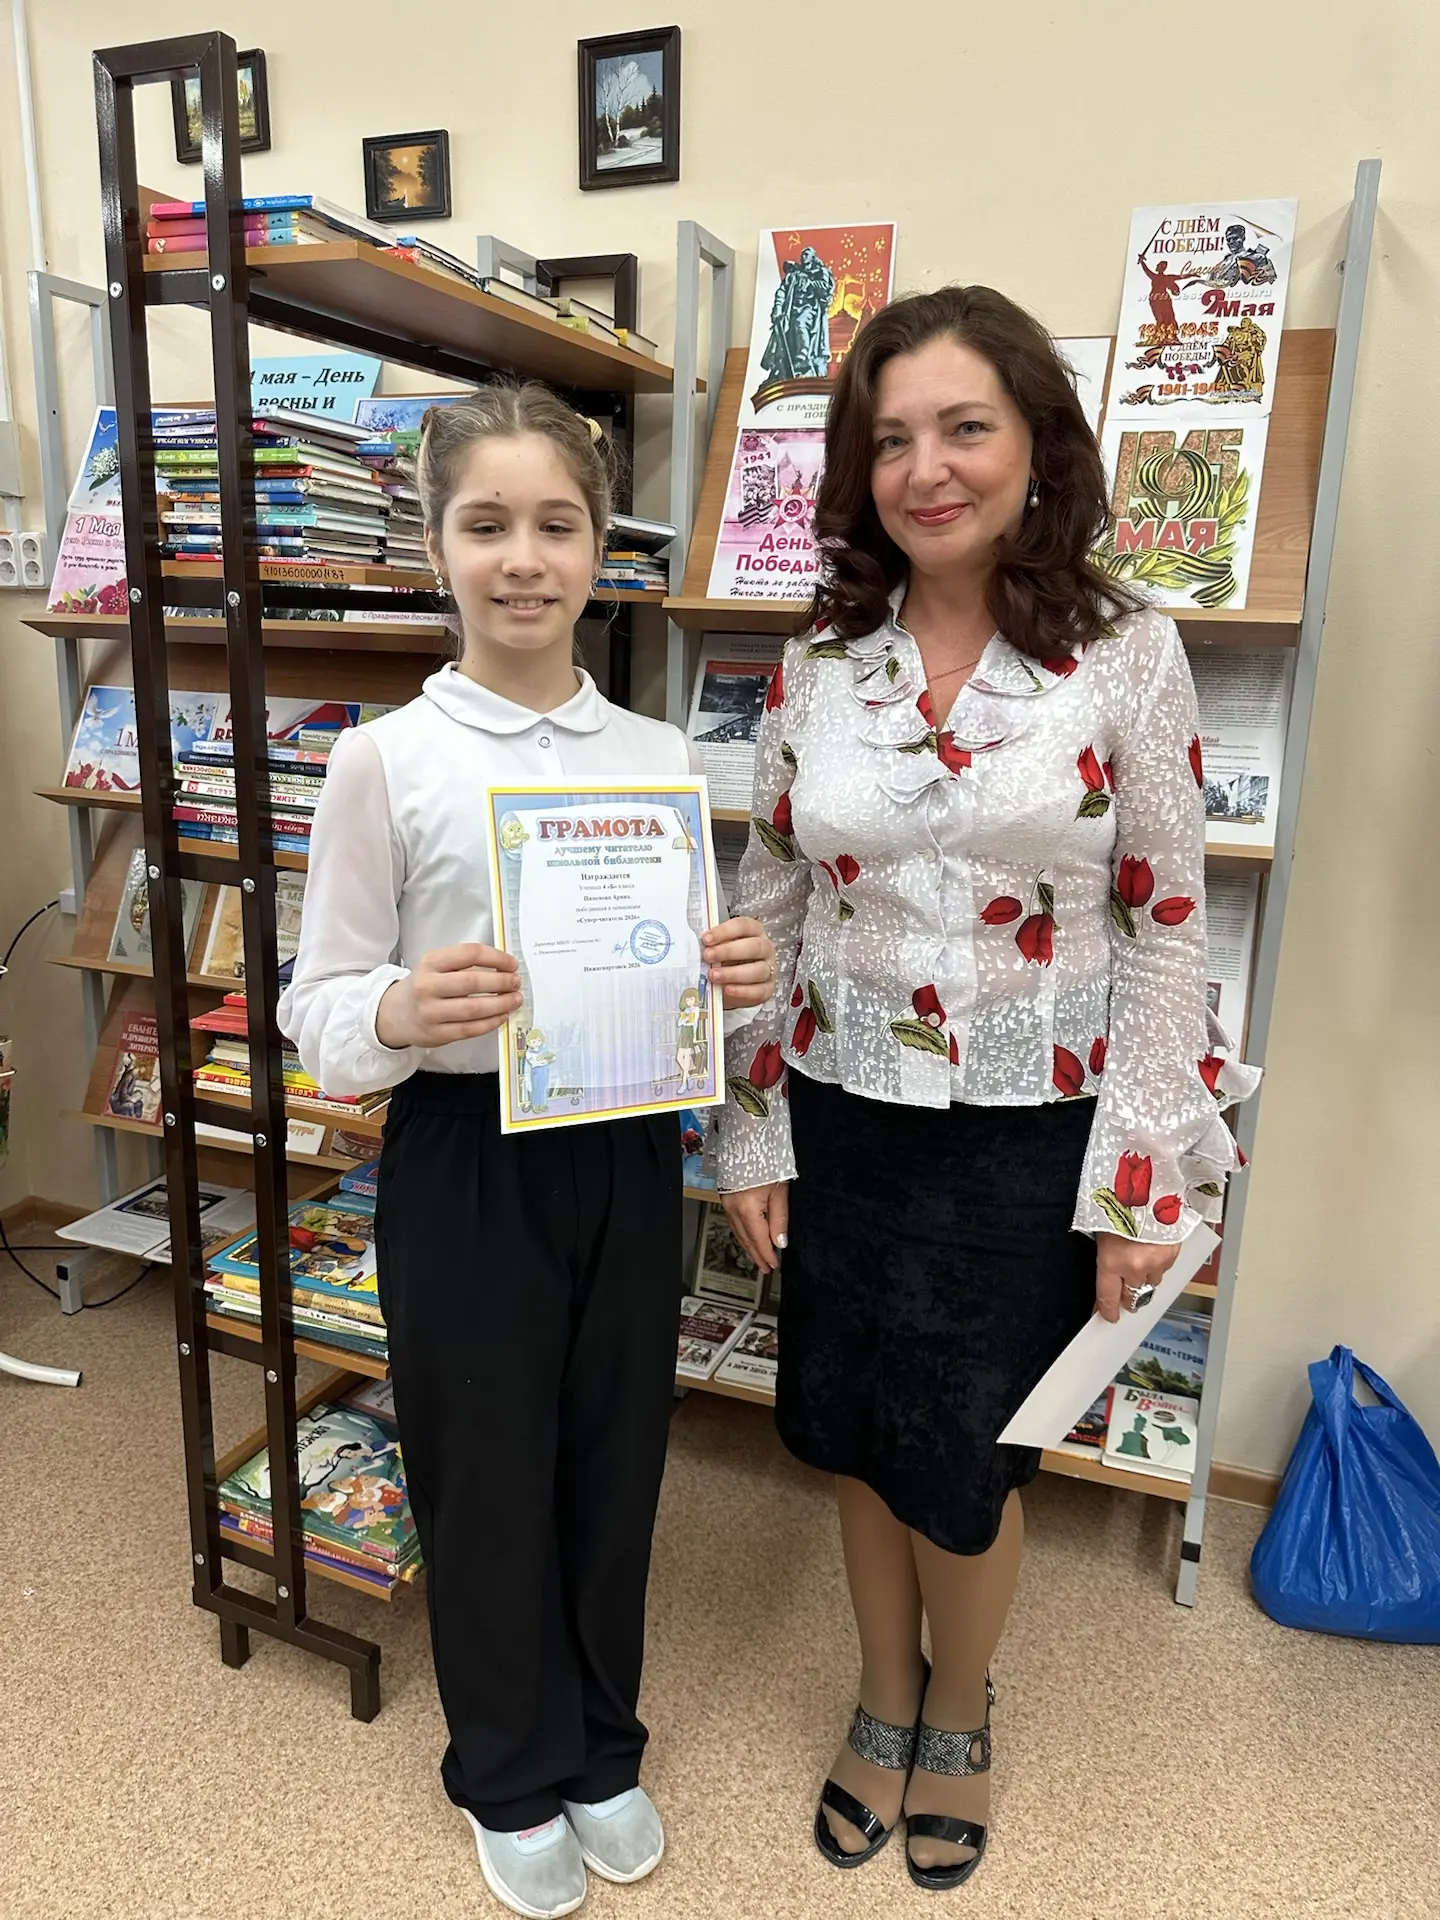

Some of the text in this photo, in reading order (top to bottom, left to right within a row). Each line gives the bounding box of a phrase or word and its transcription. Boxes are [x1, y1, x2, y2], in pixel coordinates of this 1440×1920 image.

[1161, 215, 1221, 237] С ДНЁМ
[1153, 236, 1224, 255] ПОБЕДЫ!
[1215, 300, 1275, 318] Мая
[1164, 351, 1211, 362] ПОБЕДЫ!
[260, 371, 297, 385] мая
[313, 367, 365, 387] День
[323, 396, 336, 409] и
[787, 403, 828, 412] ПРАЗДН
[743, 451, 771, 465] 1941
[76, 517, 121, 536] 1 Мая
[759, 533, 813, 552] День
[1115, 518, 1220, 556] МАЯ
[736, 554, 820, 575] Победы
[735, 577, 769, 586] Никто
[730, 587, 764, 597] Ничего
[368, 612, 409, 620] Праздником
[539, 818, 665, 839] ГРАМОТА
[554, 843, 653, 857] лучшему читателю
[546, 855, 662, 867] школьной библиотеки
[128, 1023, 158, 1036] ЕВАНГЕ
